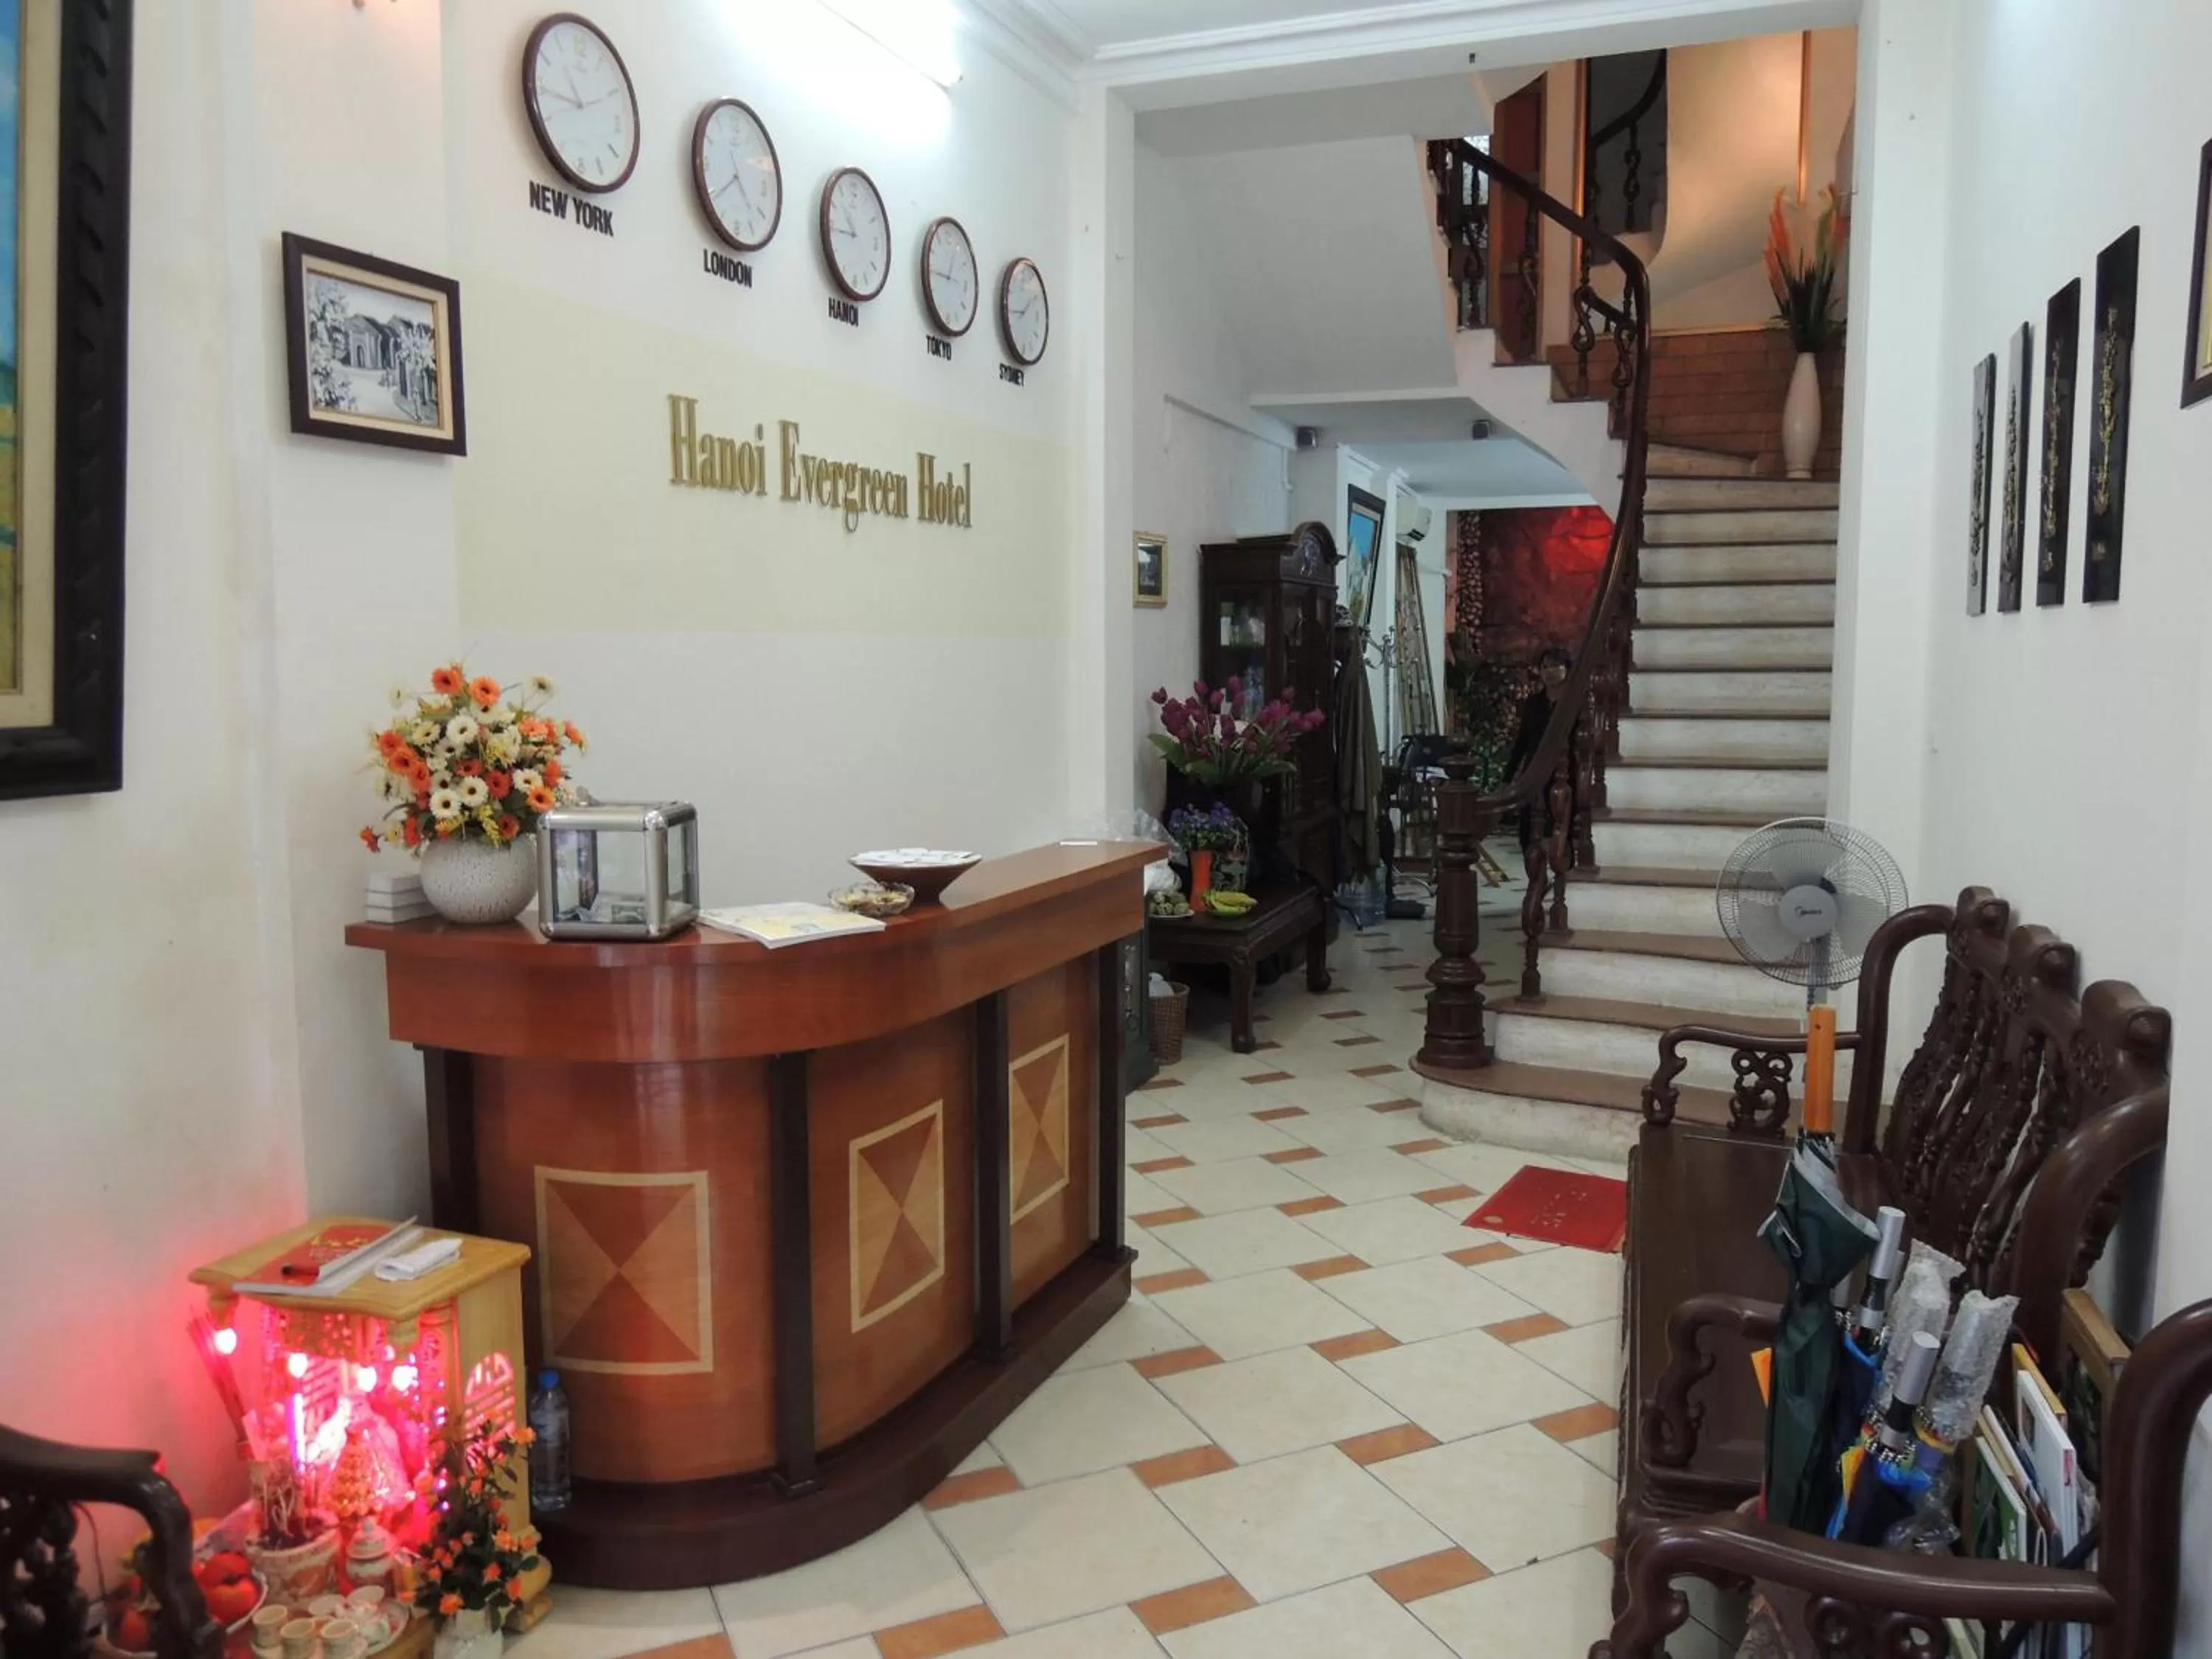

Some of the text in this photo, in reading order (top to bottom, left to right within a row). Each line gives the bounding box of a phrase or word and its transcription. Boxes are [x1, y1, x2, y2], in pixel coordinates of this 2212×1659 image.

[529, 179, 613, 237] NEW YORK
[703, 248, 753, 288] LONDON
[828, 296, 858, 327] HANOI
[926, 334, 952, 361] TOKYO
[667, 393, 973, 532] Hanoi Evergreen Hotel
